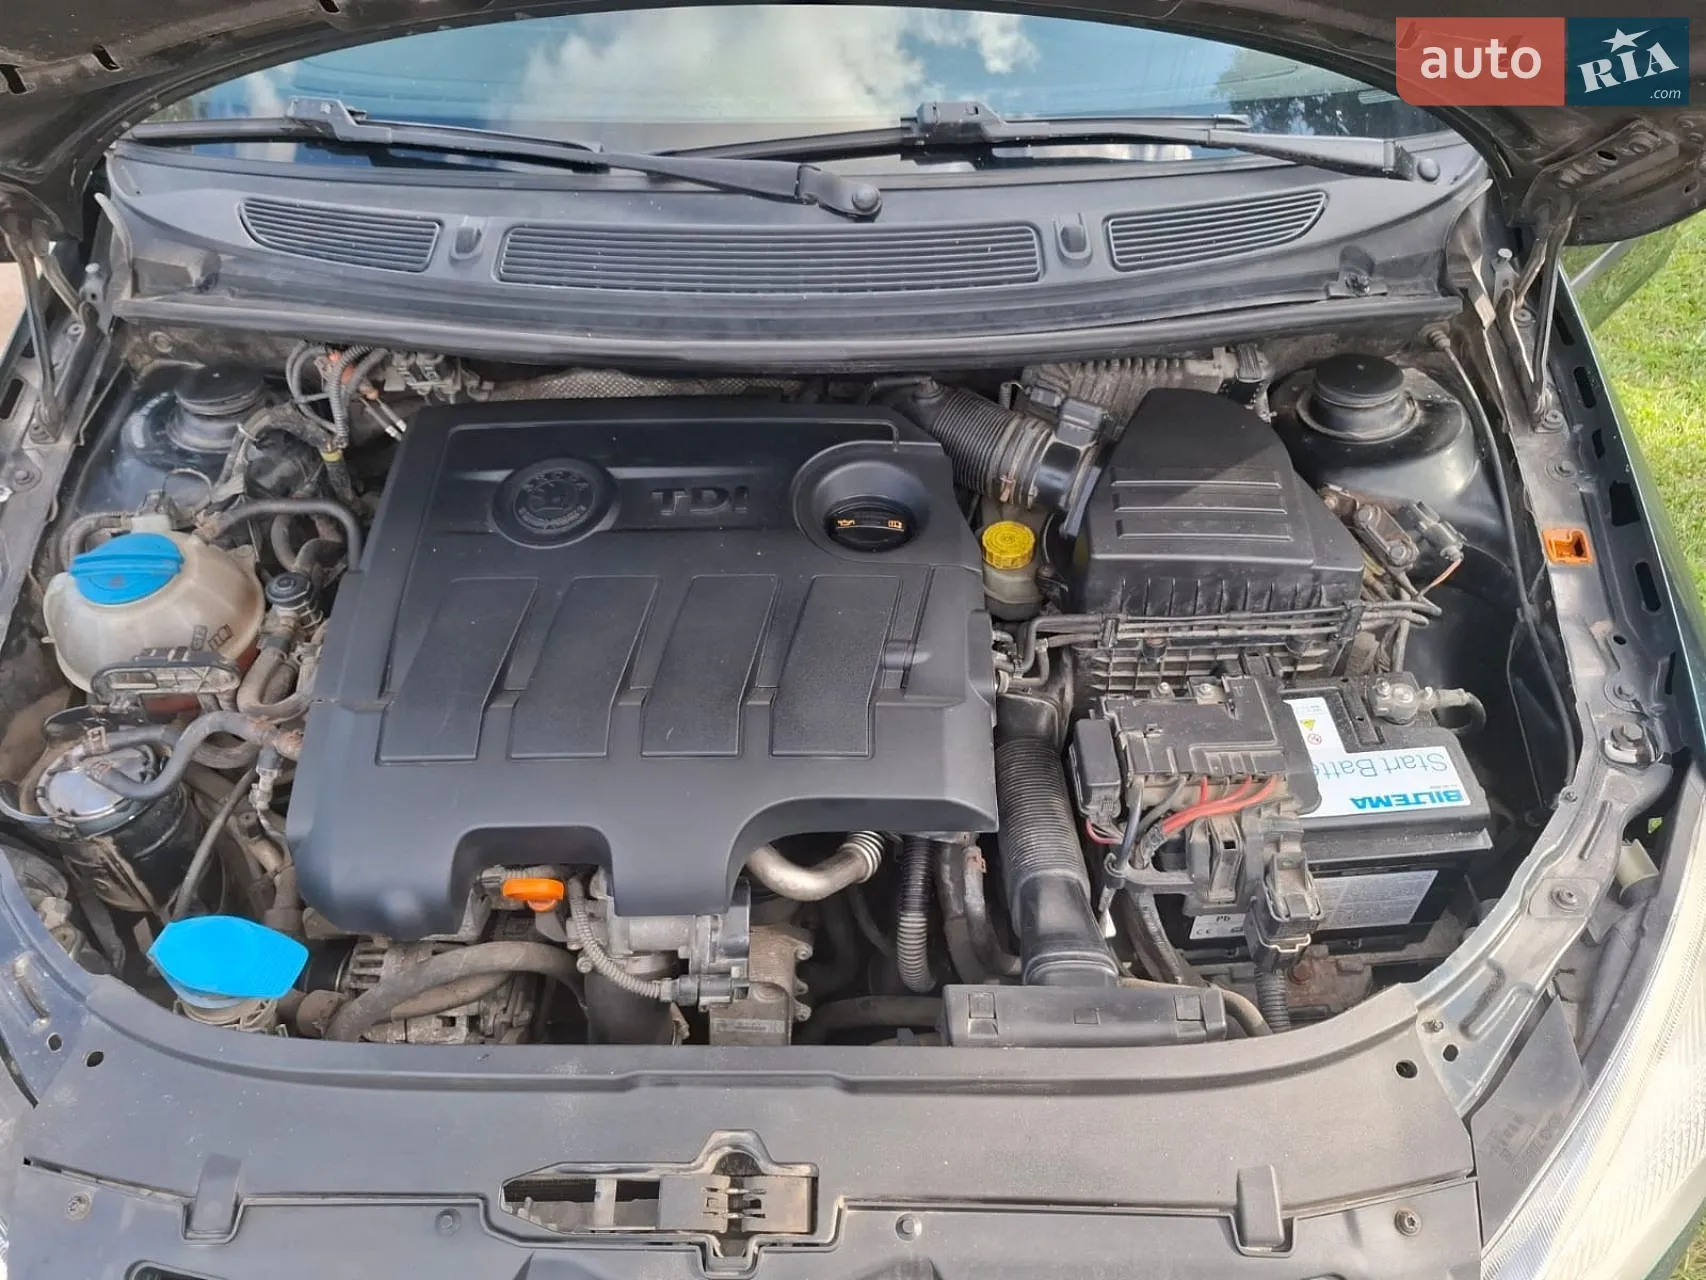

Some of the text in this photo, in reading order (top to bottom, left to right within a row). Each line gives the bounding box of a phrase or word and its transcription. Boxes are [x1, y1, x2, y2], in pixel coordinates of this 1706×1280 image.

[651, 487, 749, 516] TDI
[1380, 753, 1448, 773] Start
[1350, 789, 1464, 809] BILTEMA
